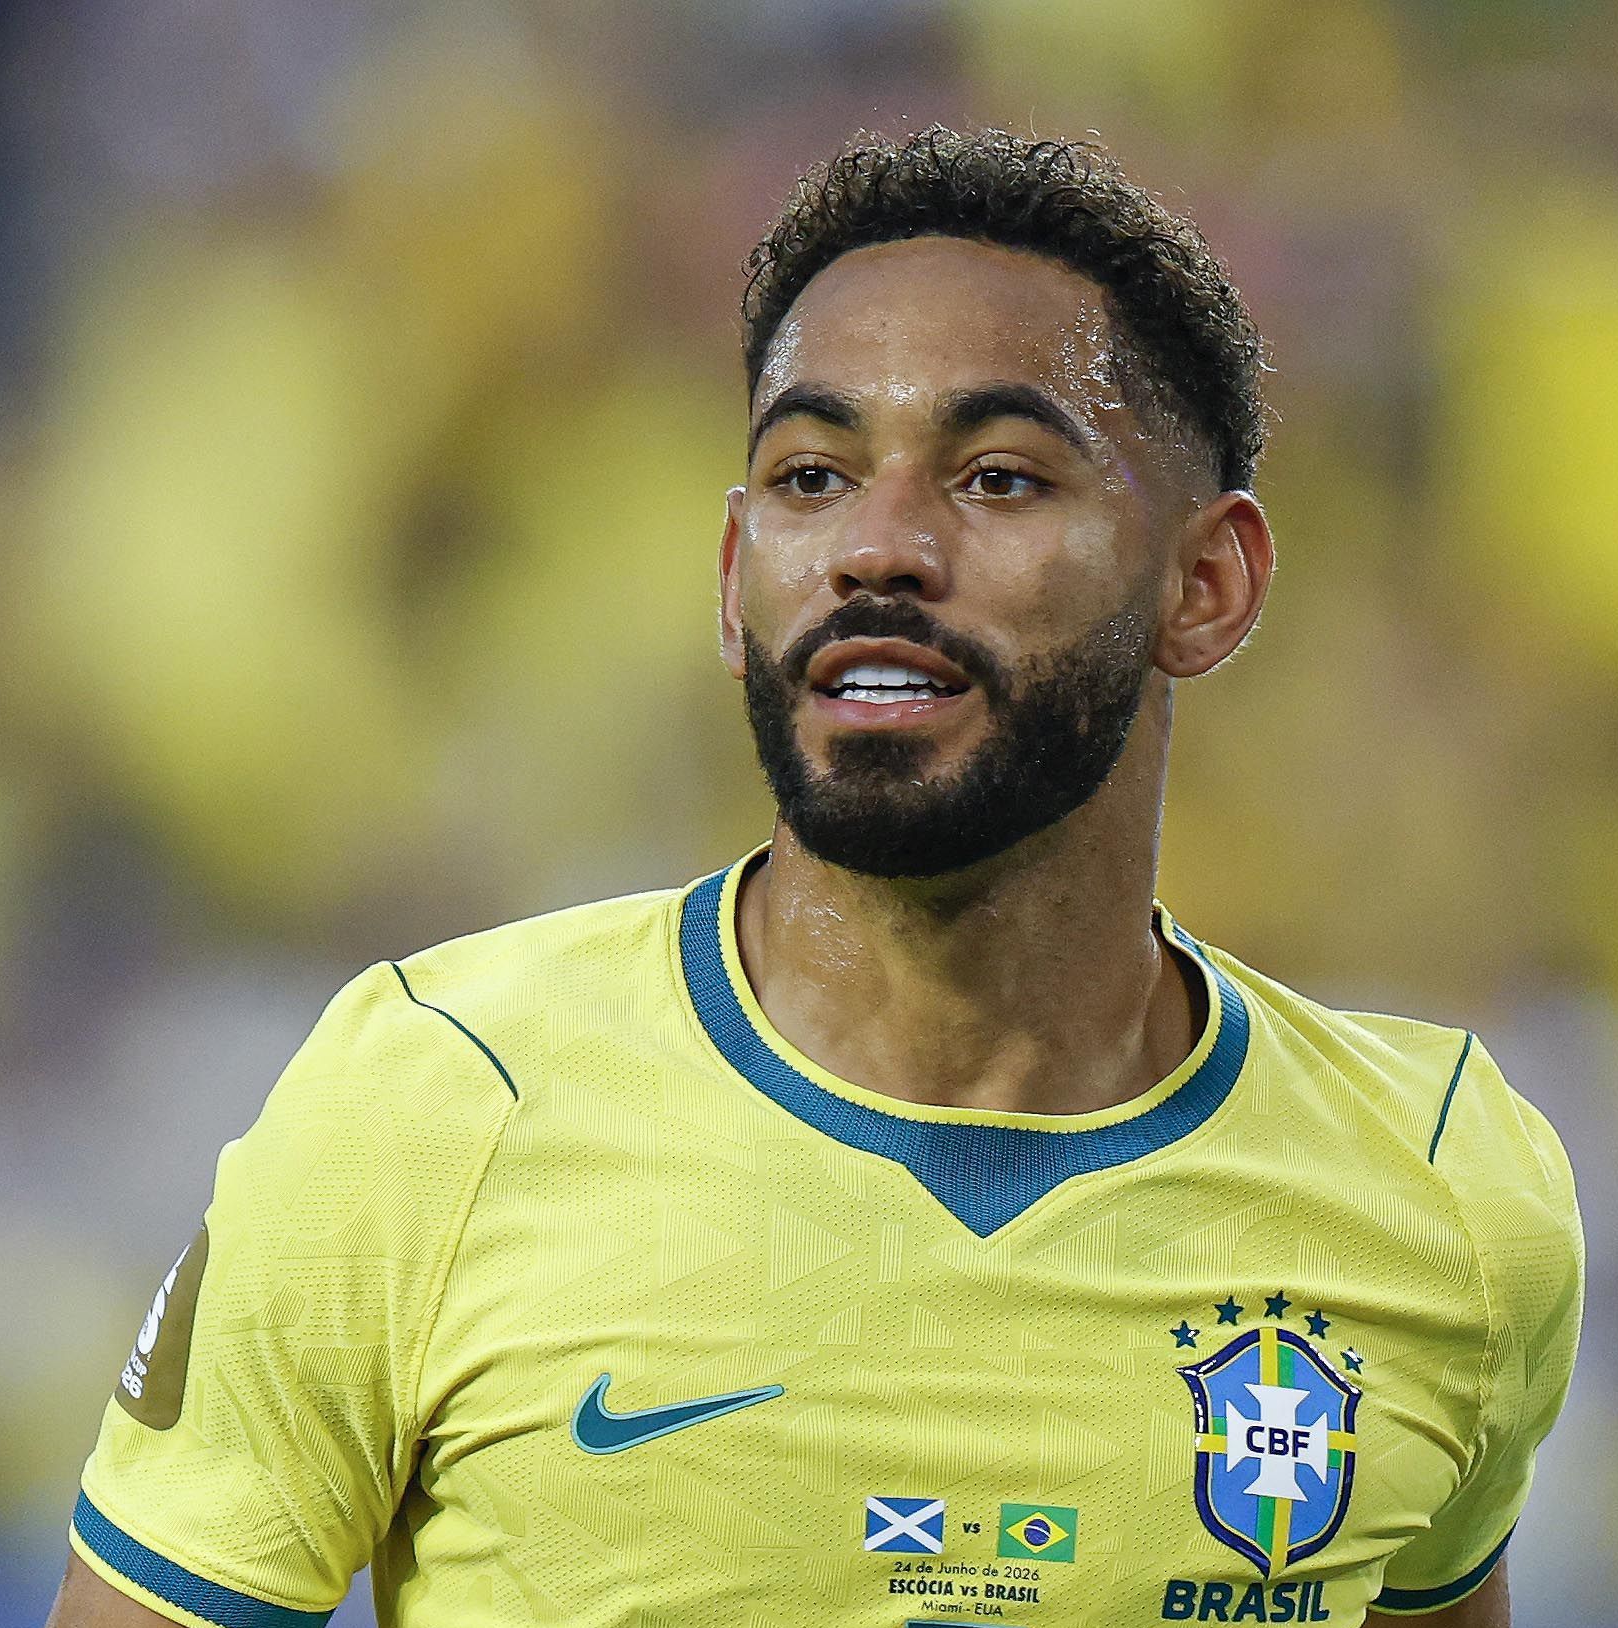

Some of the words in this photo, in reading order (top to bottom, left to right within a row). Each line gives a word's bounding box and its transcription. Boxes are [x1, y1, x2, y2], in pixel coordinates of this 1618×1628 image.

[1246, 1425, 1310, 1458] CBF
[962, 1522, 981, 1534] vs
[893, 1561, 912, 1573] 24
[916, 1562, 933, 1574] de
[937, 1562, 977, 1576] Junho
[982, 1564, 999, 1577] de
[1004, 1566, 1040, 1581] 2026
[888, 1576, 954, 1596] ESCÓCIA
[960, 1585, 978, 1597] vs
[984, 1583, 1041, 1603] BRASIL
[1161, 1578, 1331, 1624] BRASIL
[921, 1600, 963, 1614] Miami
[974, 1602, 1003, 1617] EUA
